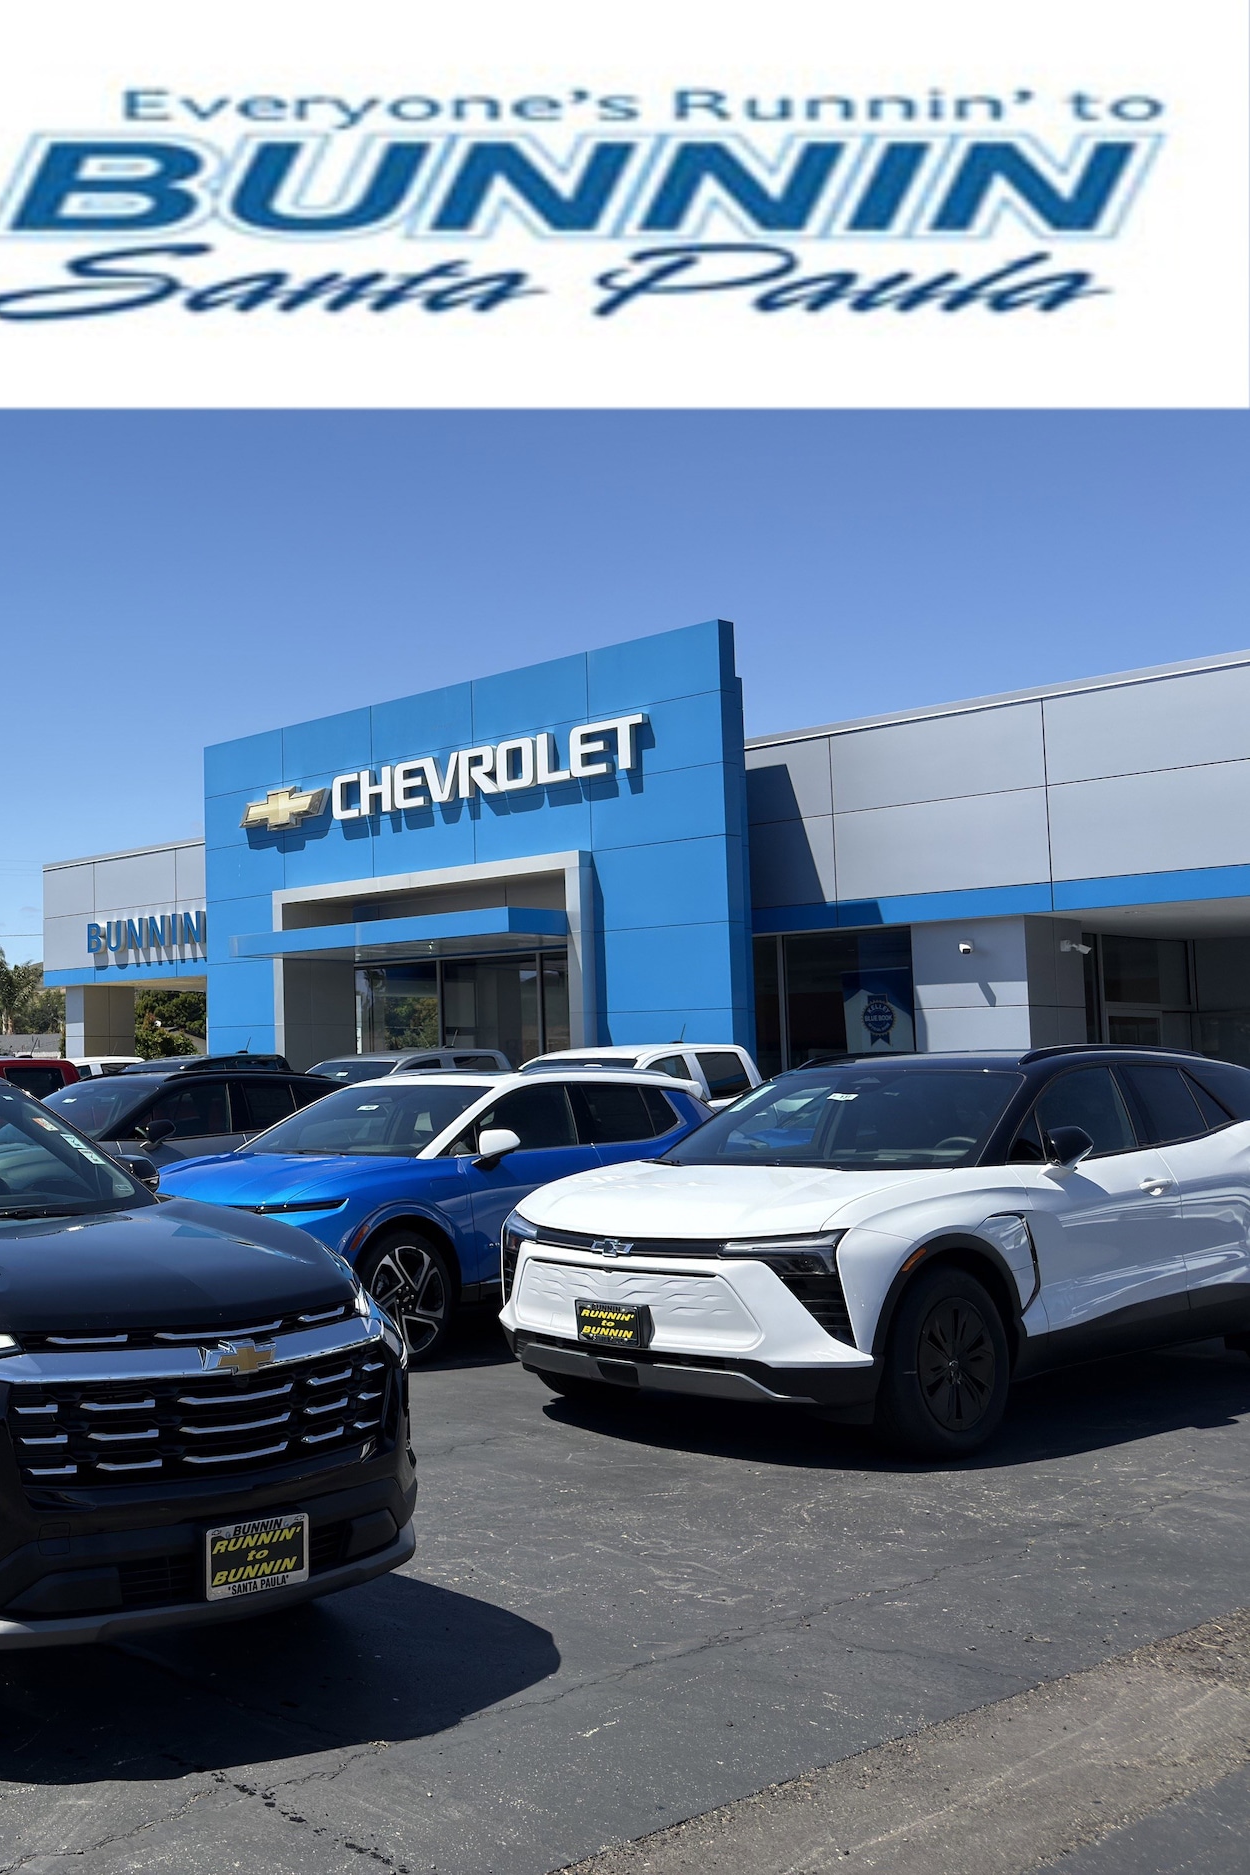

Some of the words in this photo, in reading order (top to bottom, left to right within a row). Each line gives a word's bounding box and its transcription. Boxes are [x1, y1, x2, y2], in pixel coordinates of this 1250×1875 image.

[331, 712, 648, 821] CHEVROLET
[87, 910, 206, 954] BUNNIN
[867, 1003, 891, 1014] KELLEY
[580, 1308, 635, 1322] RUNNIN'
[601, 1319, 616, 1327] to
[581, 1325, 634, 1339] BUNNIN
[232, 1518, 284, 1537] BUNNIN
[211, 1526, 302, 1555] RUNNIN'
[247, 1549, 269, 1561] to
[211, 1555, 298, 1587] BUNNIN
